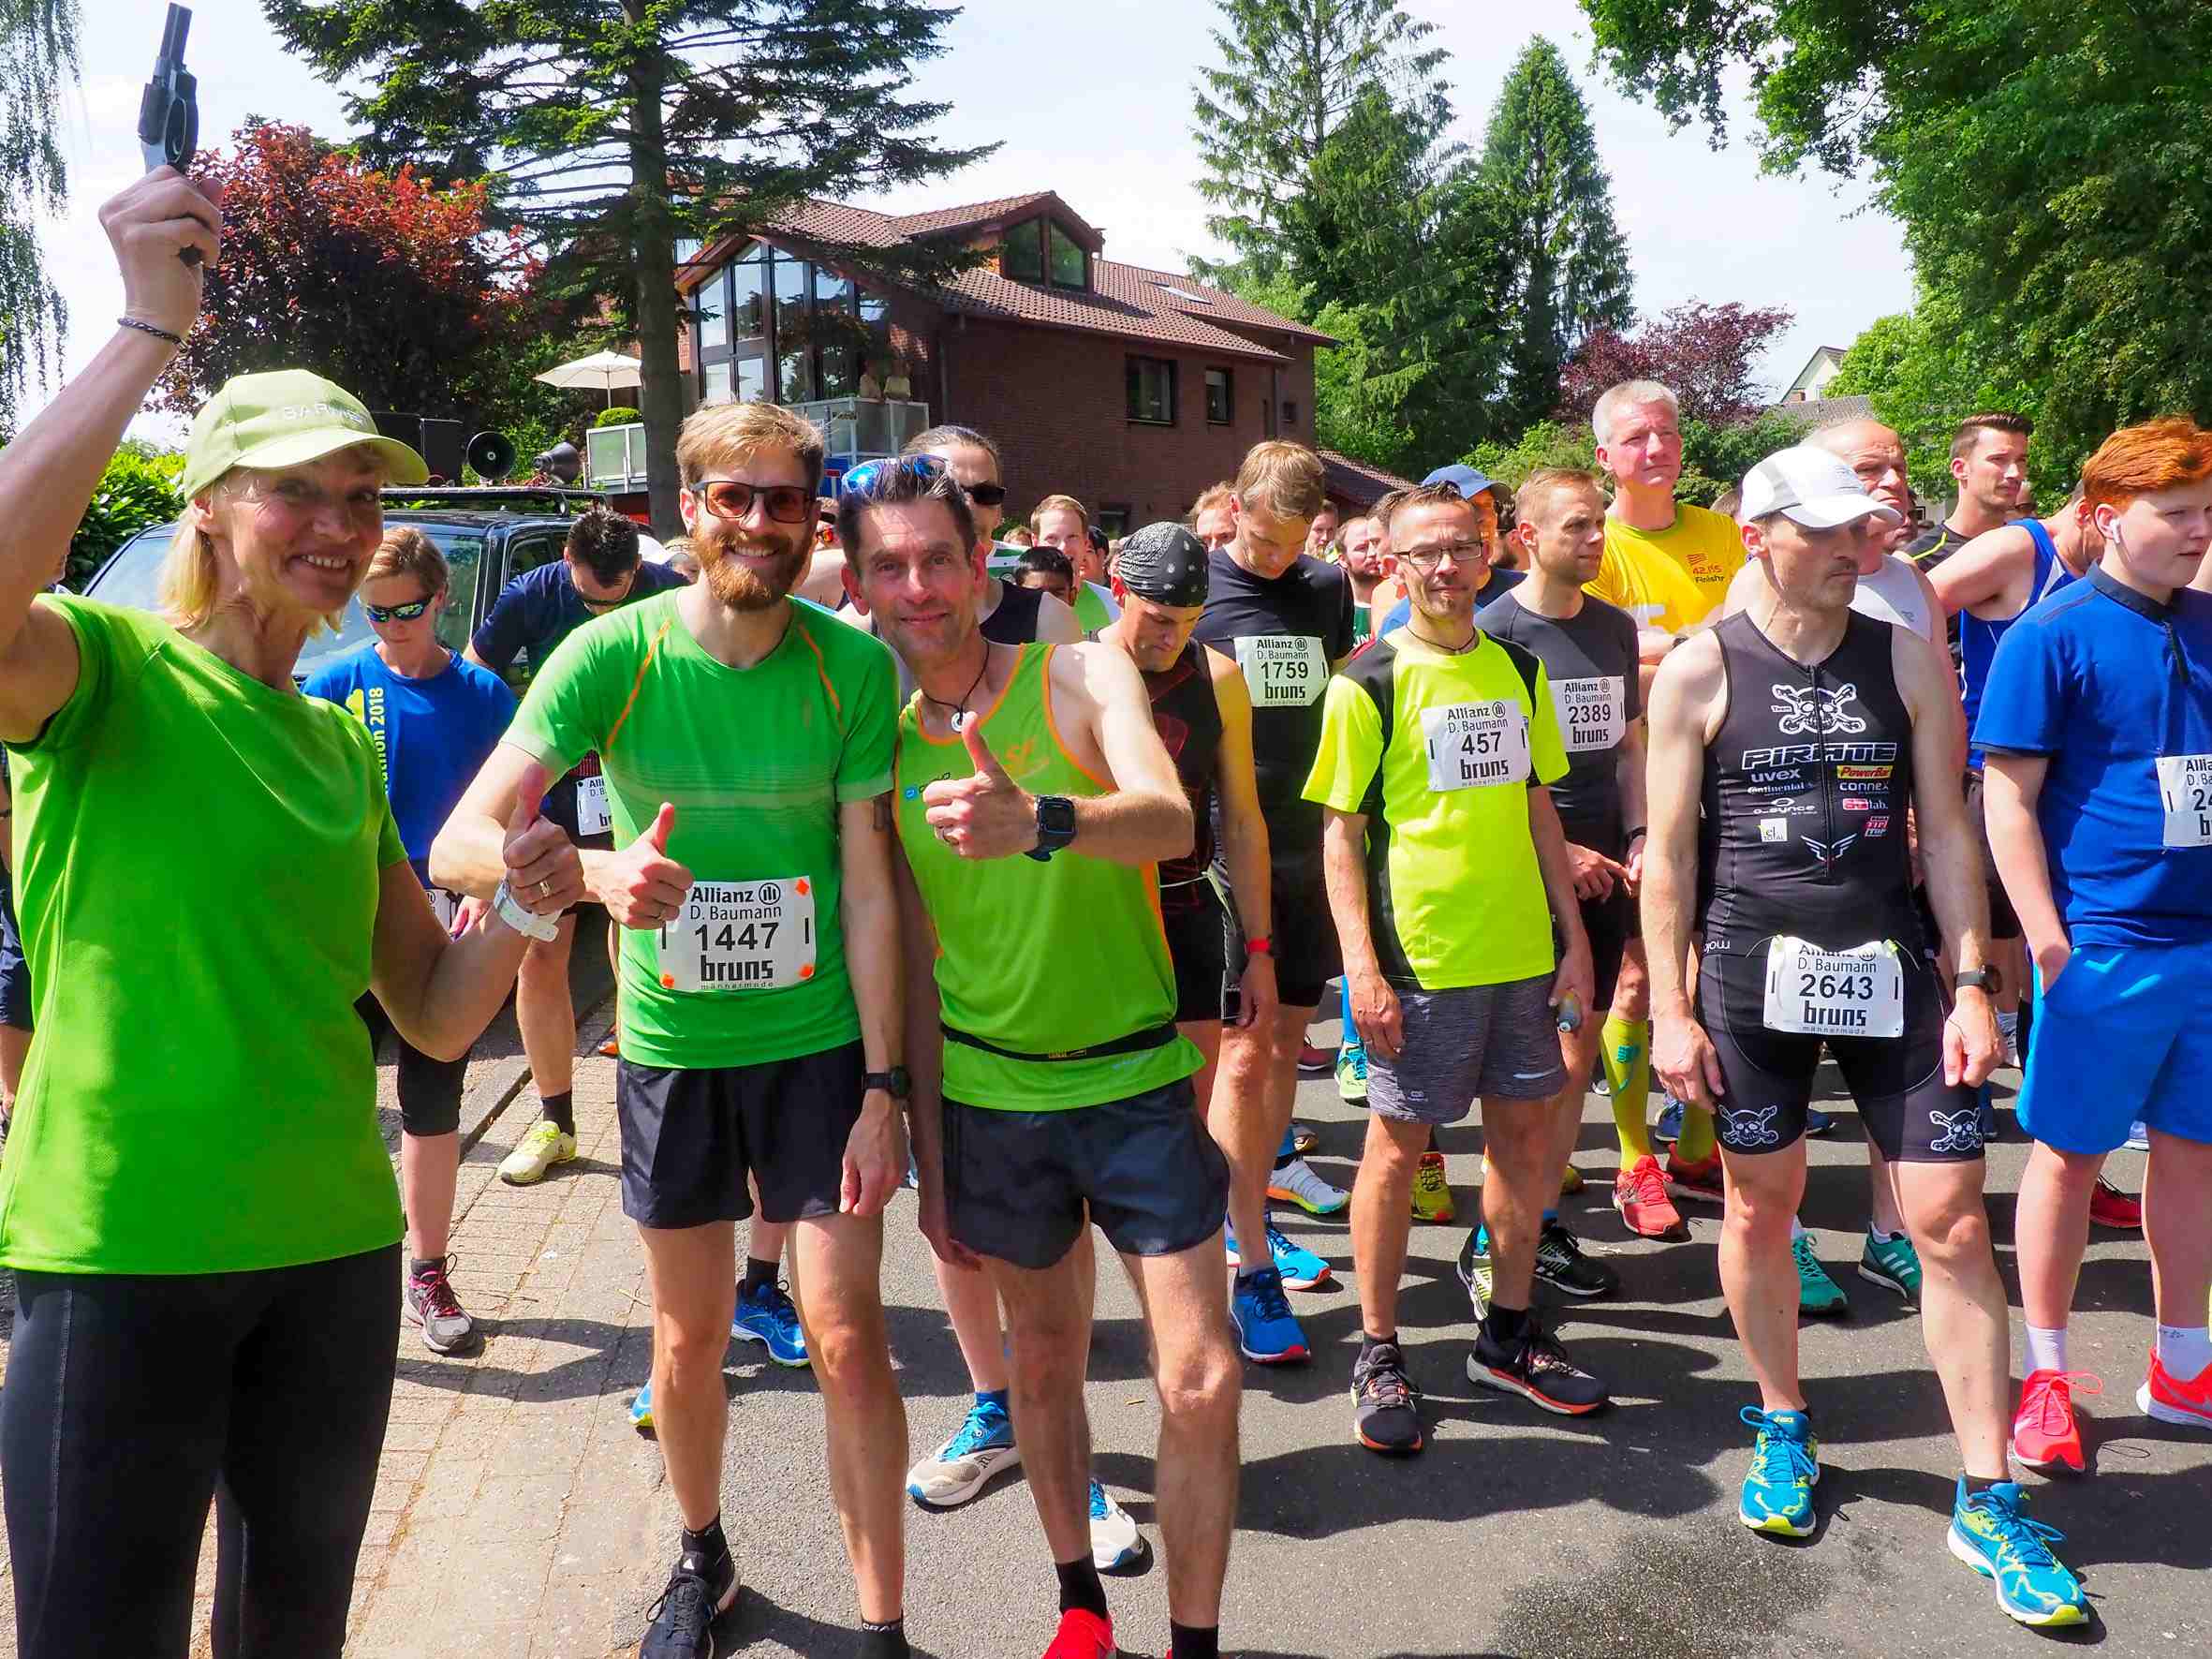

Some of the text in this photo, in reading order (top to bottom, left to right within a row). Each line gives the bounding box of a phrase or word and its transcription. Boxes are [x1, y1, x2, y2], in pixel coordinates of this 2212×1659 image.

[1257, 639, 1292, 649] Allianz
[1257, 650, 1309, 660] D. Baumann
[1261, 661, 1309, 679] 1759
[1264, 682, 1305, 700] bruns
[1564, 682, 1599, 693] Allianz
[368, 687, 386, 727] 2018
[1565, 693, 1612, 704] D. Baumann
[1447, 705, 1491, 720] Allianz
[1568, 704, 1611, 724] 2389
[1448, 718, 1509, 733] D. Baumann
[1461, 731, 1502, 756] 457
[1572, 726, 1609, 744] bruns
[1742, 742, 1897, 770] PIRATE
[1460, 759, 1510, 780] bruns
[1750, 768, 1802, 783] uvex
[1839, 783, 1889, 792] connex
[2187, 774, 2200, 786] D.
[690, 886, 755, 904] Allianz
[690, 905, 782, 921] D. Baumann
[694, 922, 779, 951] 1447
[700, 955, 774, 982] bruns
[1798, 956, 1877, 973] D. Baumann
[1798, 973, 1874, 1000] 2643
[1804, 1000, 1866, 1027] bruns
